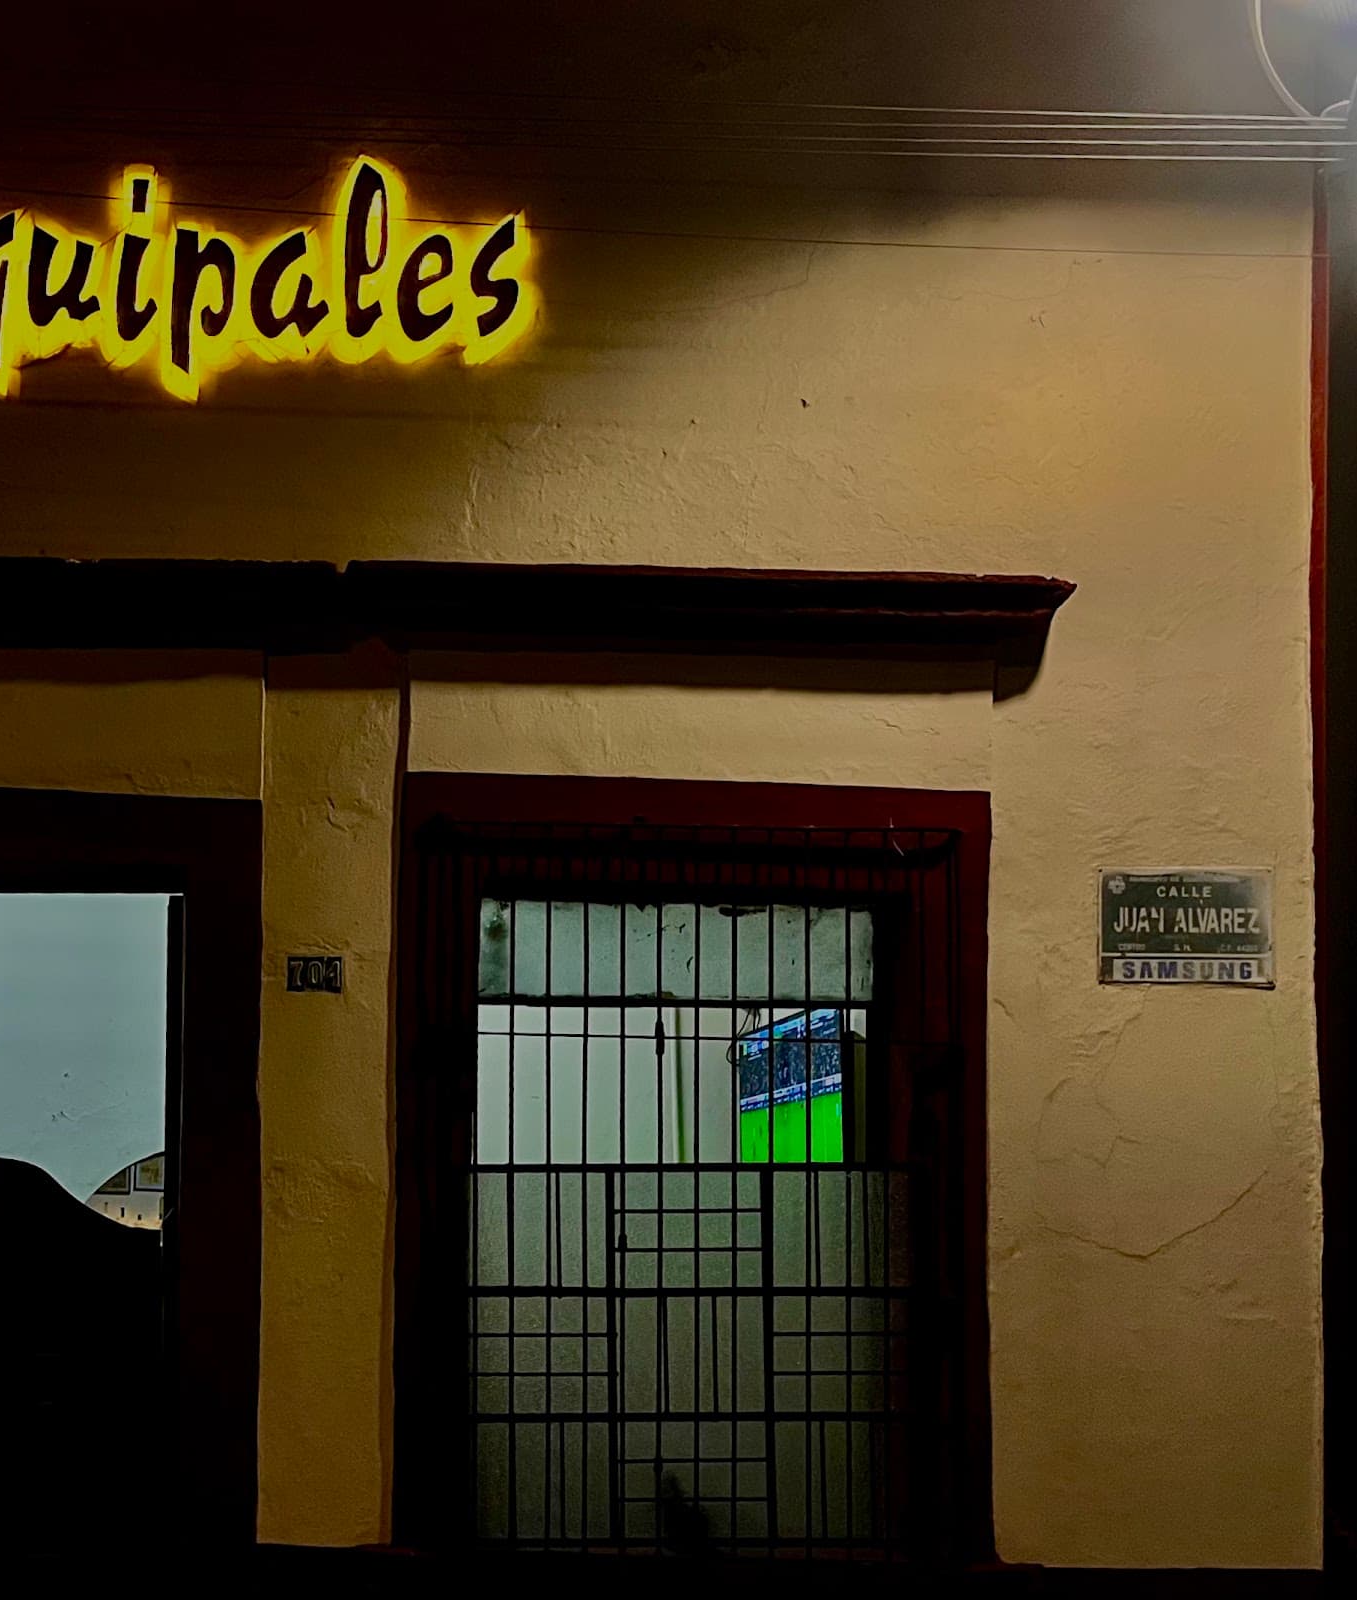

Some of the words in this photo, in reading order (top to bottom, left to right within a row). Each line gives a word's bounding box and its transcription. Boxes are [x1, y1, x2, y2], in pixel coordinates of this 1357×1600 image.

[1156, 885, 1213, 898] CALLE
[1113, 906, 1165, 934] JUAN
[1173, 907, 1261, 934] ALVAREZ
[1122, 961, 1253, 980] SAMSUNG
